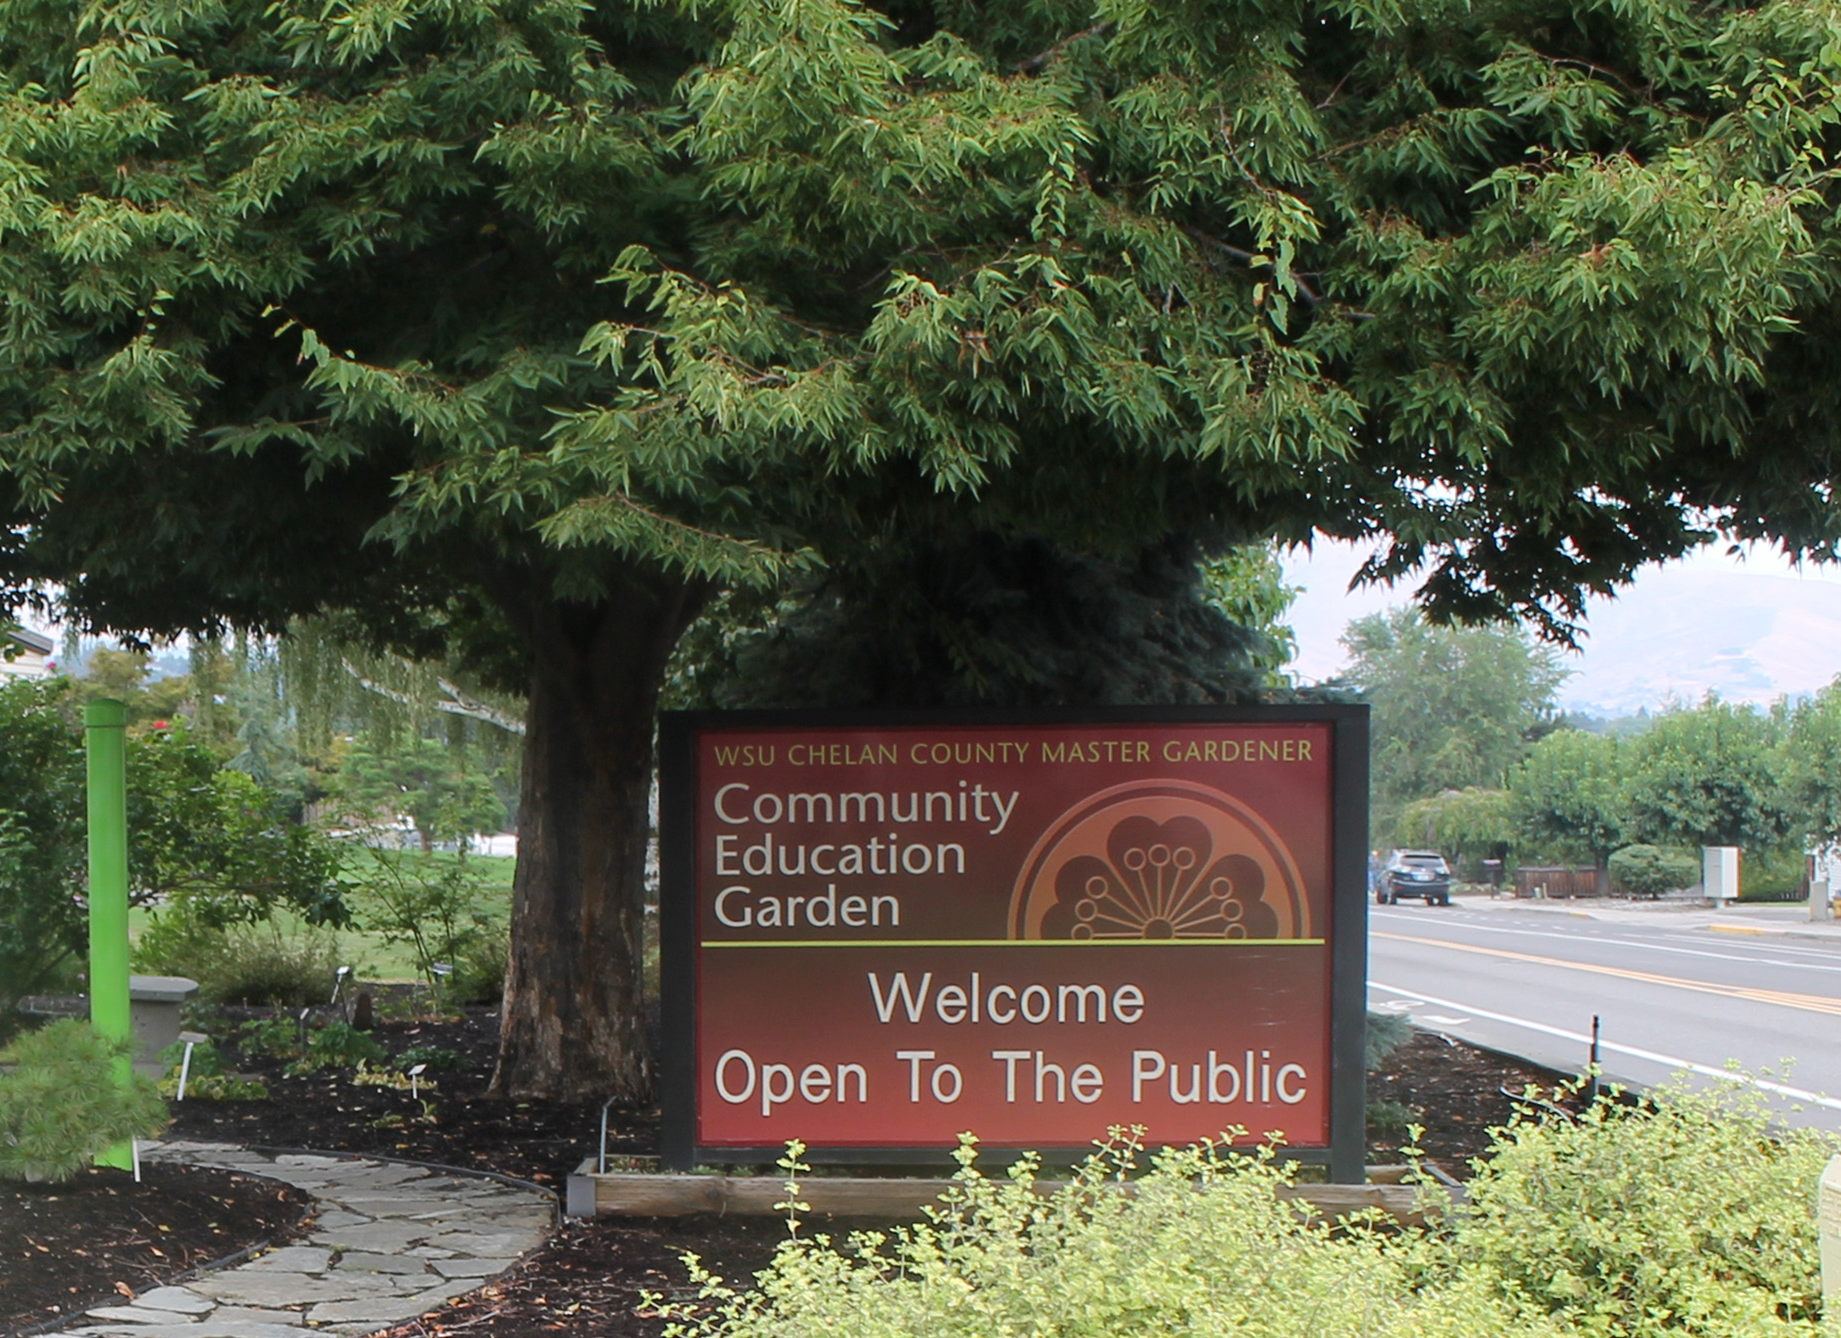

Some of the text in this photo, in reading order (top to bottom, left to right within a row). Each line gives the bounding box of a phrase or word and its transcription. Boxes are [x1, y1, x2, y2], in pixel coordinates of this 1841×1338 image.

[714, 740, 1314, 766] WSU CHELAN COUNTY MASTER GARDENER
[714, 780, 1019, 835] Community
[716, 833, 965, 876] Education
[714, 884, 900, 927] Garden
[868, 972, 1145, 1023] Welcome
[715, 1049, 1307, 1116] Open To The Public
